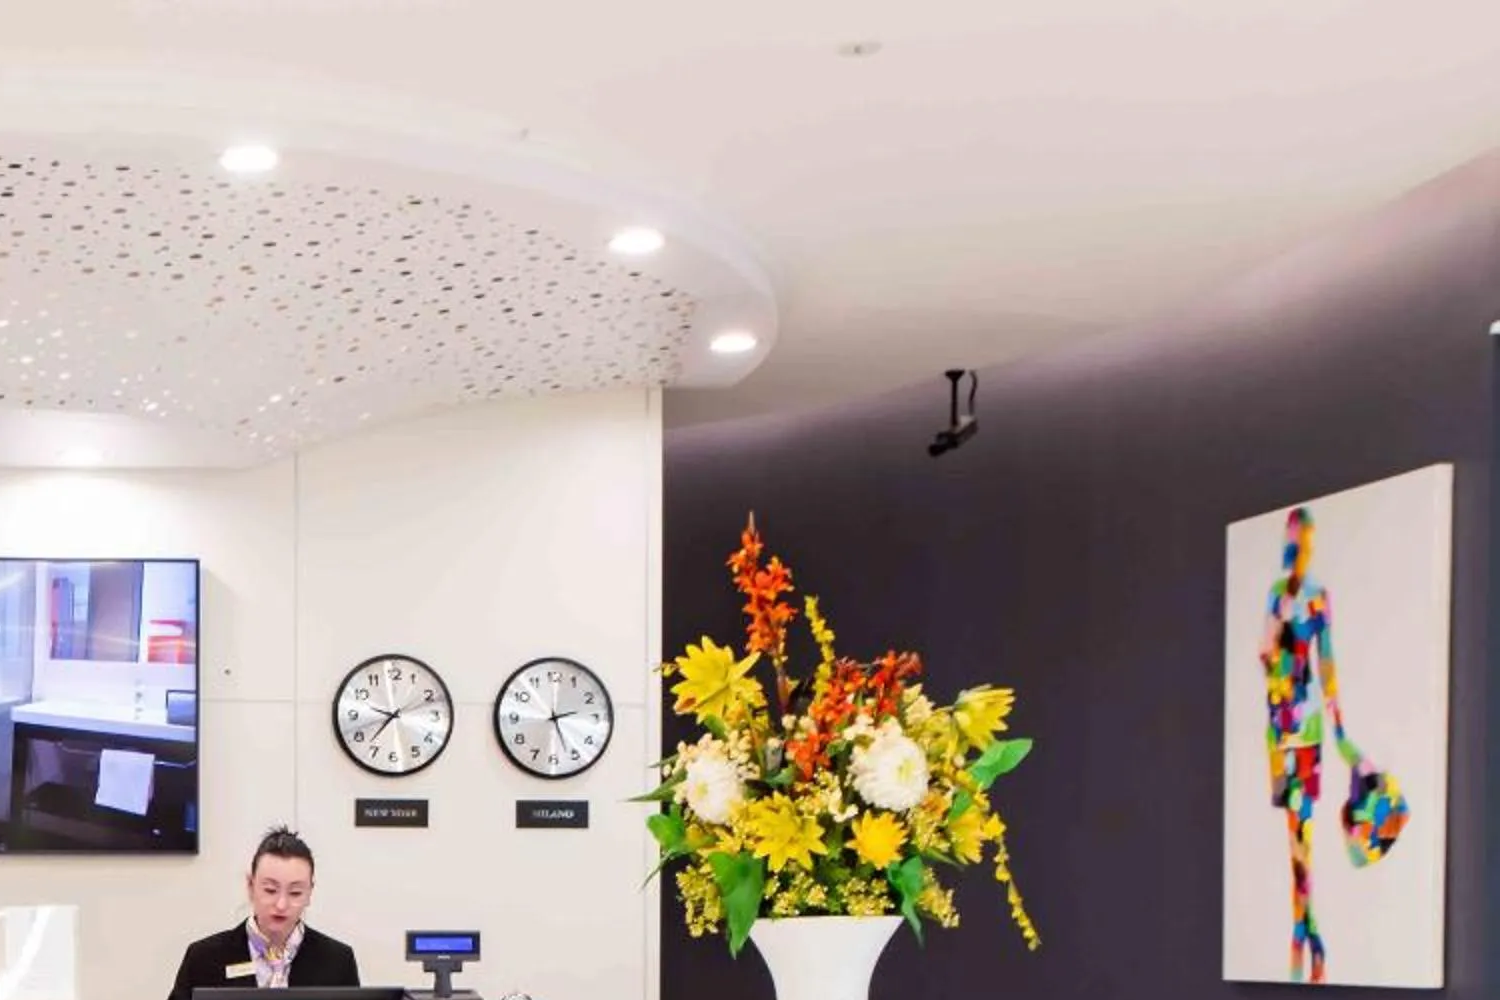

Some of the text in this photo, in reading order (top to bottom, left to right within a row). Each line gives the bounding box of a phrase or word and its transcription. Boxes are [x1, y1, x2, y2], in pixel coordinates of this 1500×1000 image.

[368, 674, 379, 686] 11
[529, 677, 539, 688] 11
[547, 671, 562, 683] 12
[355, 689, 369, 700] 10
[423, 690, 434, 702] 2
[514, 691, 530, 703] 10
[584, 692, 594, 704] 2
[348, 710, 359, 721] 9
[431, 710, 440, 722] 3
[509, 713, 519, 724] 9
[353, 731, 365, 743] 8
[424, 732, 433, 744] 4
[514, 734, 525, 745] 8
[584, 735, 593, 745] 4
[369, 746, 380, 758] 7
[388, 751, 398, 763] 6
[411, 746, 420, 758] 5
[530, 749, 540, 761] 7
[571, 749, 580, 760] 5
[548, 754, 559, 765] 6
[364, 808, 388, 817] NEW
[532, 809, 575, 819] MILANO
